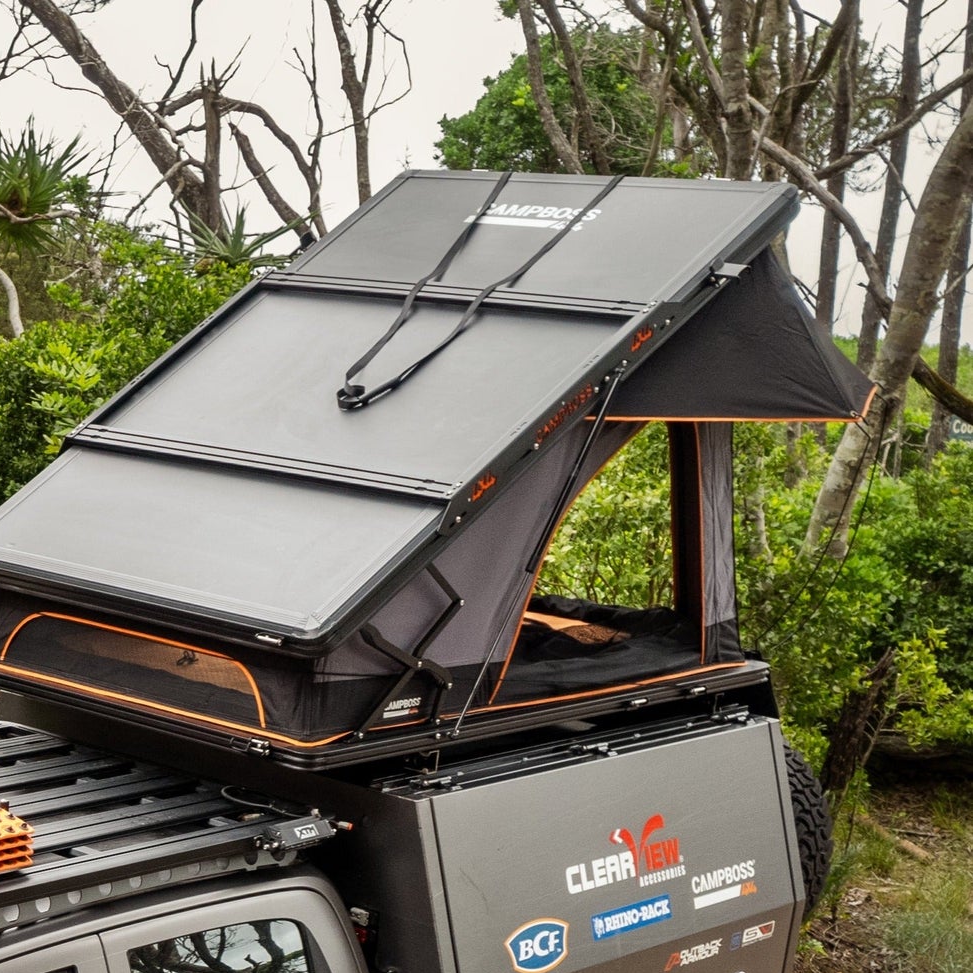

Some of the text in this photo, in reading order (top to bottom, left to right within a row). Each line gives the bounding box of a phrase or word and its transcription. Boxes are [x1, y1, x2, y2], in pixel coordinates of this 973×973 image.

[384, 697, 422, 711] AMPBOSS
[565, 813, 680, 894] CLEARVIEW
[639, 865, 687, 888] ACCESSORIES
[692, 860, 755, 894] CAMPBOSS
[604, 900, 670, 932] RHINO-RACK
[518, 930, 560, 962] BCF
[679, 938, 723, 959] OUTBACK
[680, 947, 720, 967] ARMOUR
